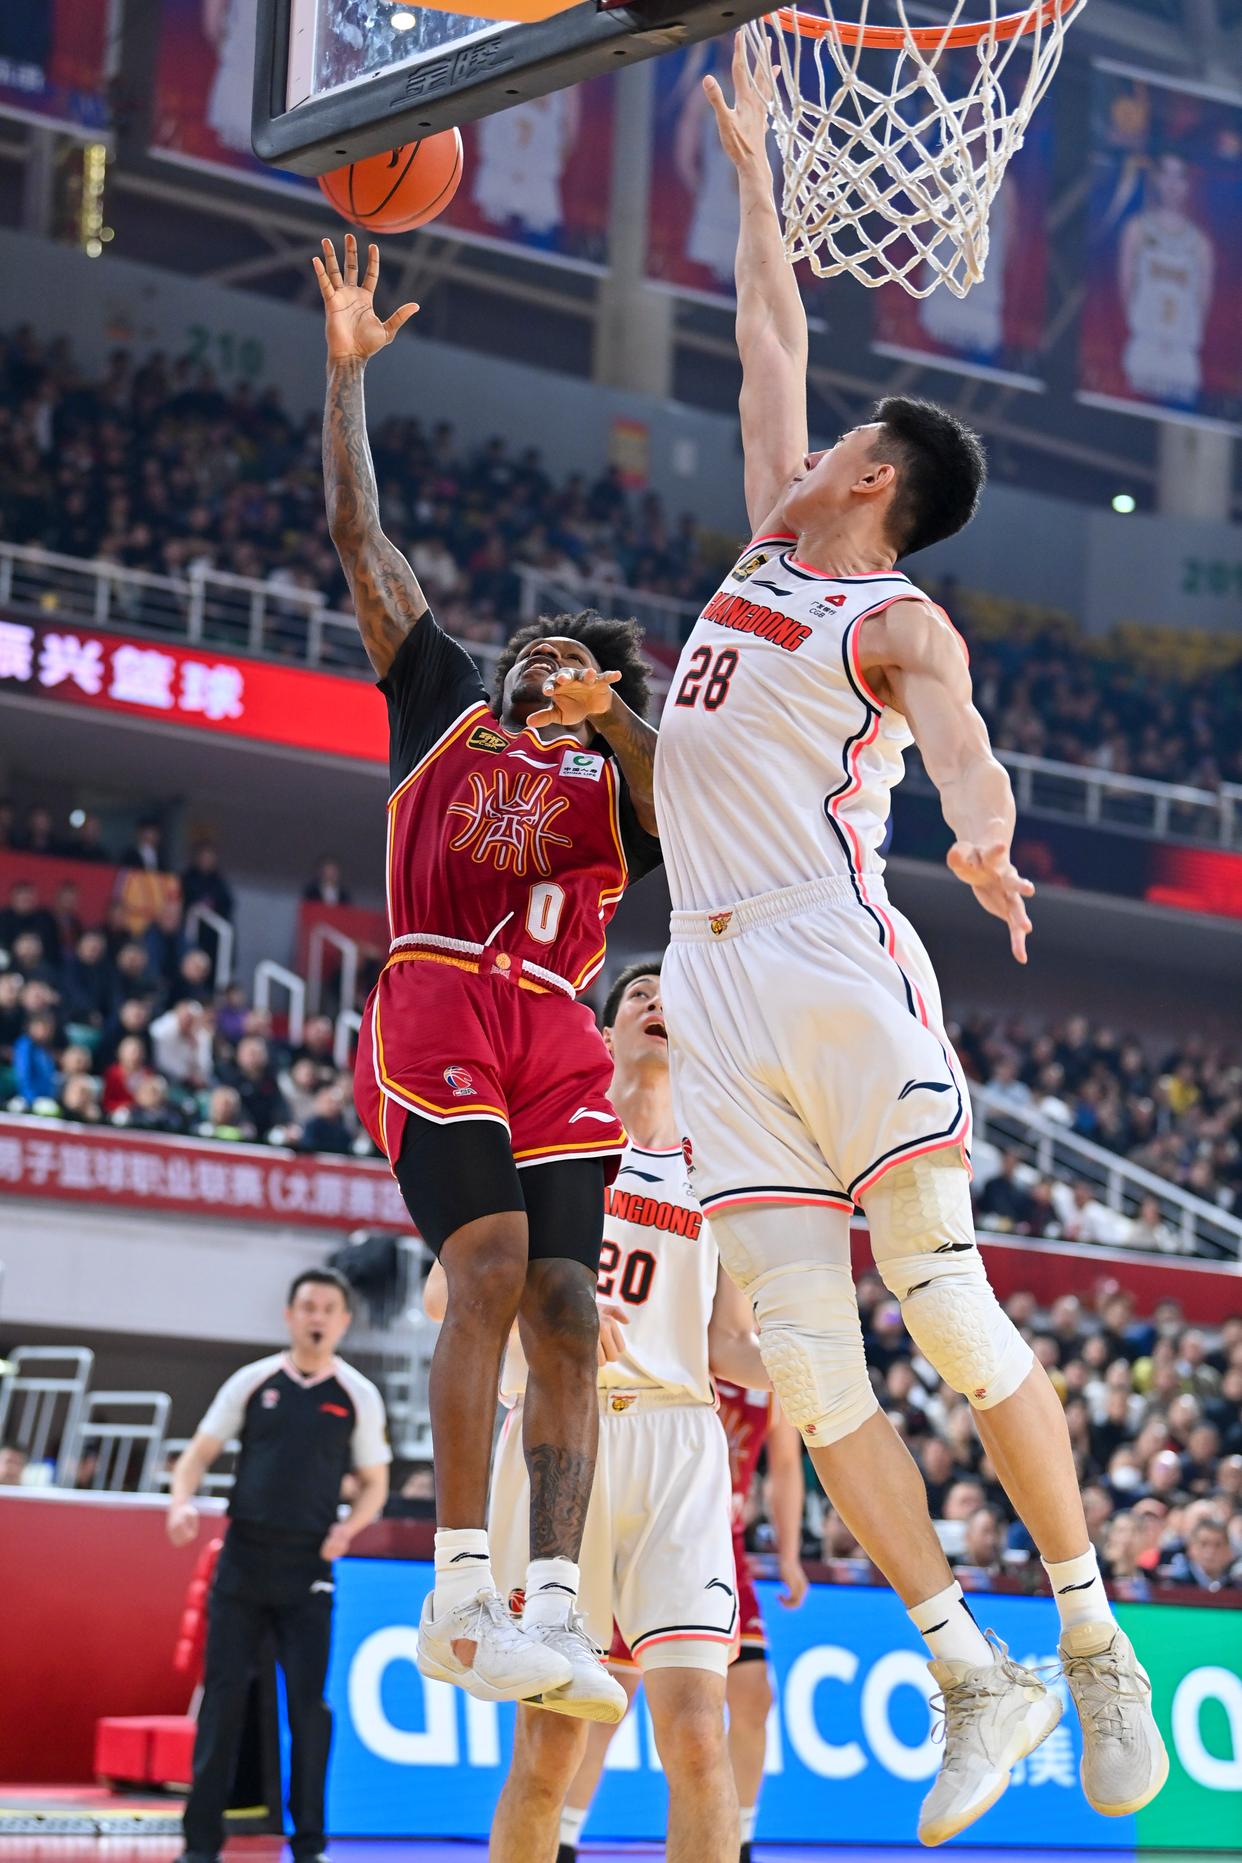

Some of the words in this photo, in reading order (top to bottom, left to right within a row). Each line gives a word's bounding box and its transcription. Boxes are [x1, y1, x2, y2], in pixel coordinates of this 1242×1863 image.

[809, 607, 826, 619] CGB
[675, 644, 740, 712] 28
[525, 881, 565, 944] 0
[596, 1239, 657, 1305] 20
[348, 1624, 946, 1781] aco
